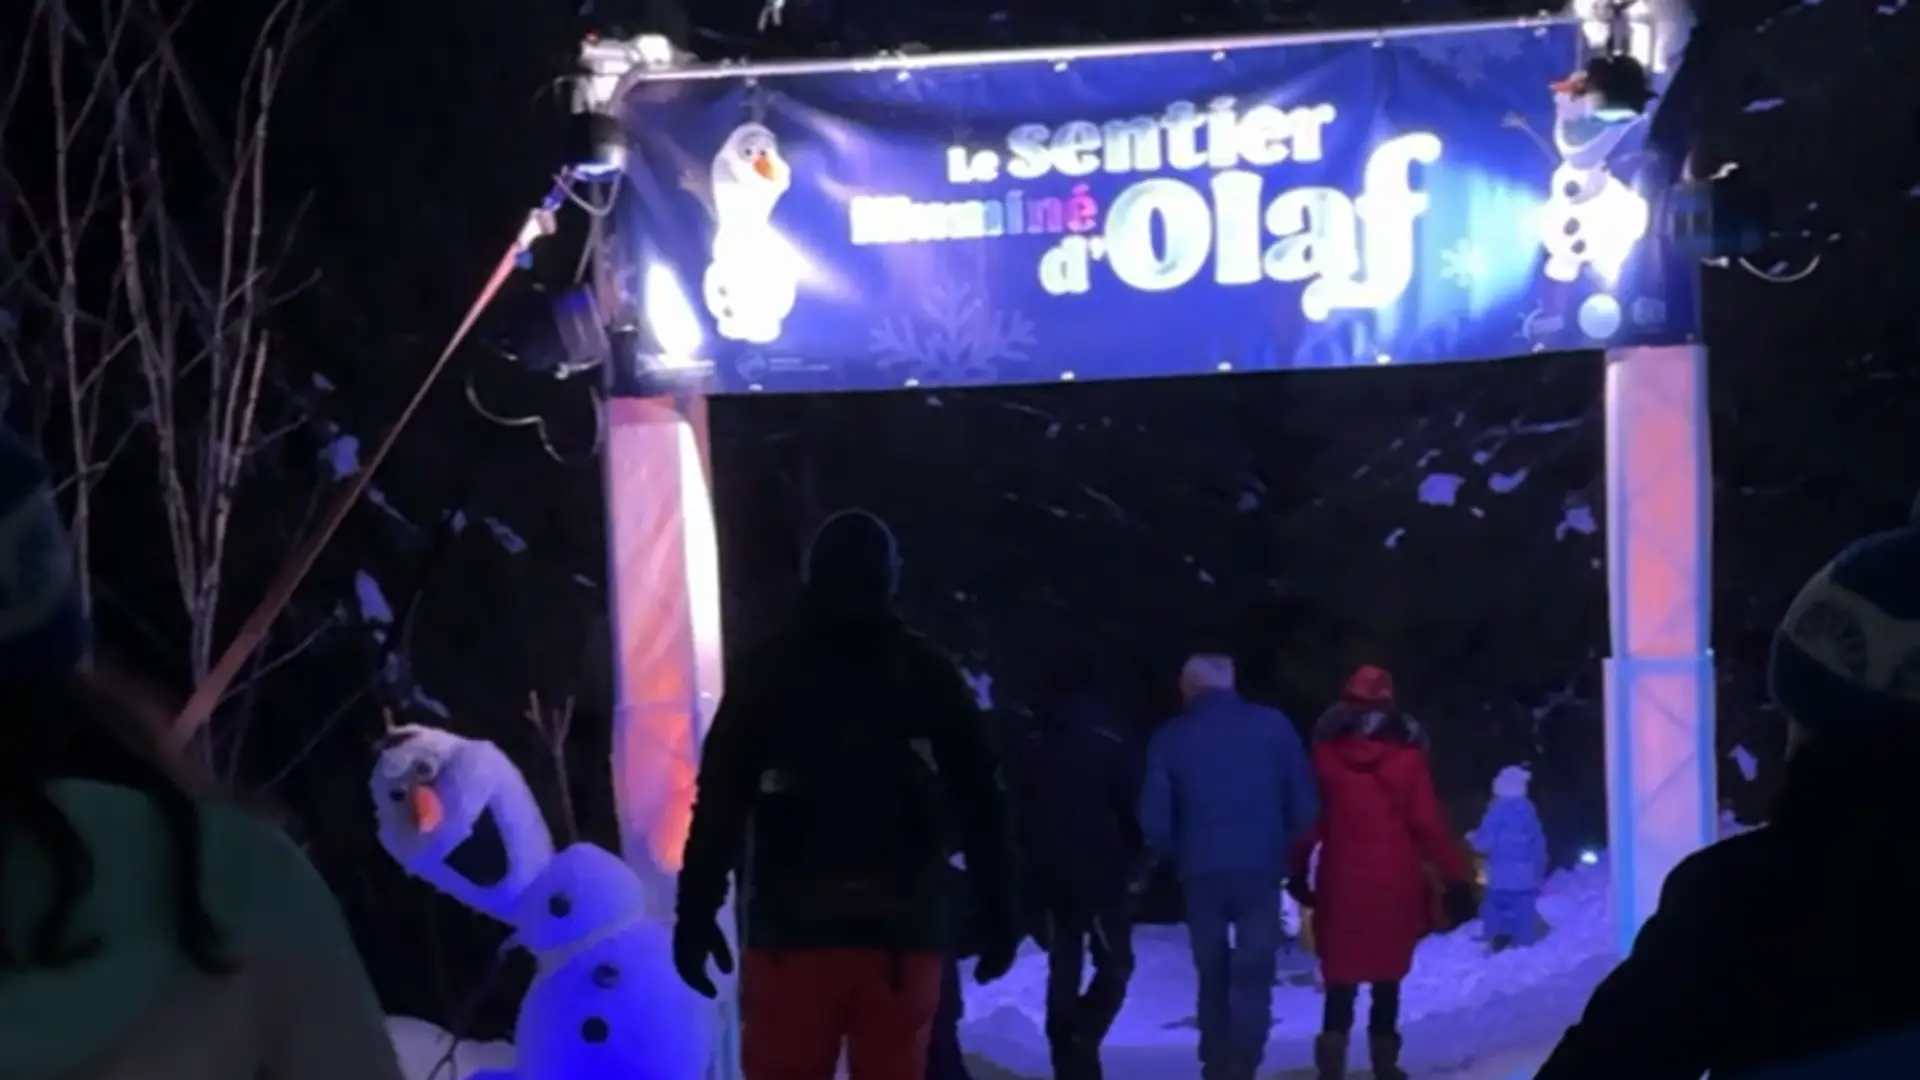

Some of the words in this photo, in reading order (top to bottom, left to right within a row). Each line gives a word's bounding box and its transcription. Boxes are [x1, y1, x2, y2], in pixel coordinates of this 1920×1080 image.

[946, 147, 1000, 183] Le
[1006, 97, 1336, 179] sentier
[1039, 132, 1443, 321] d'Olaf
